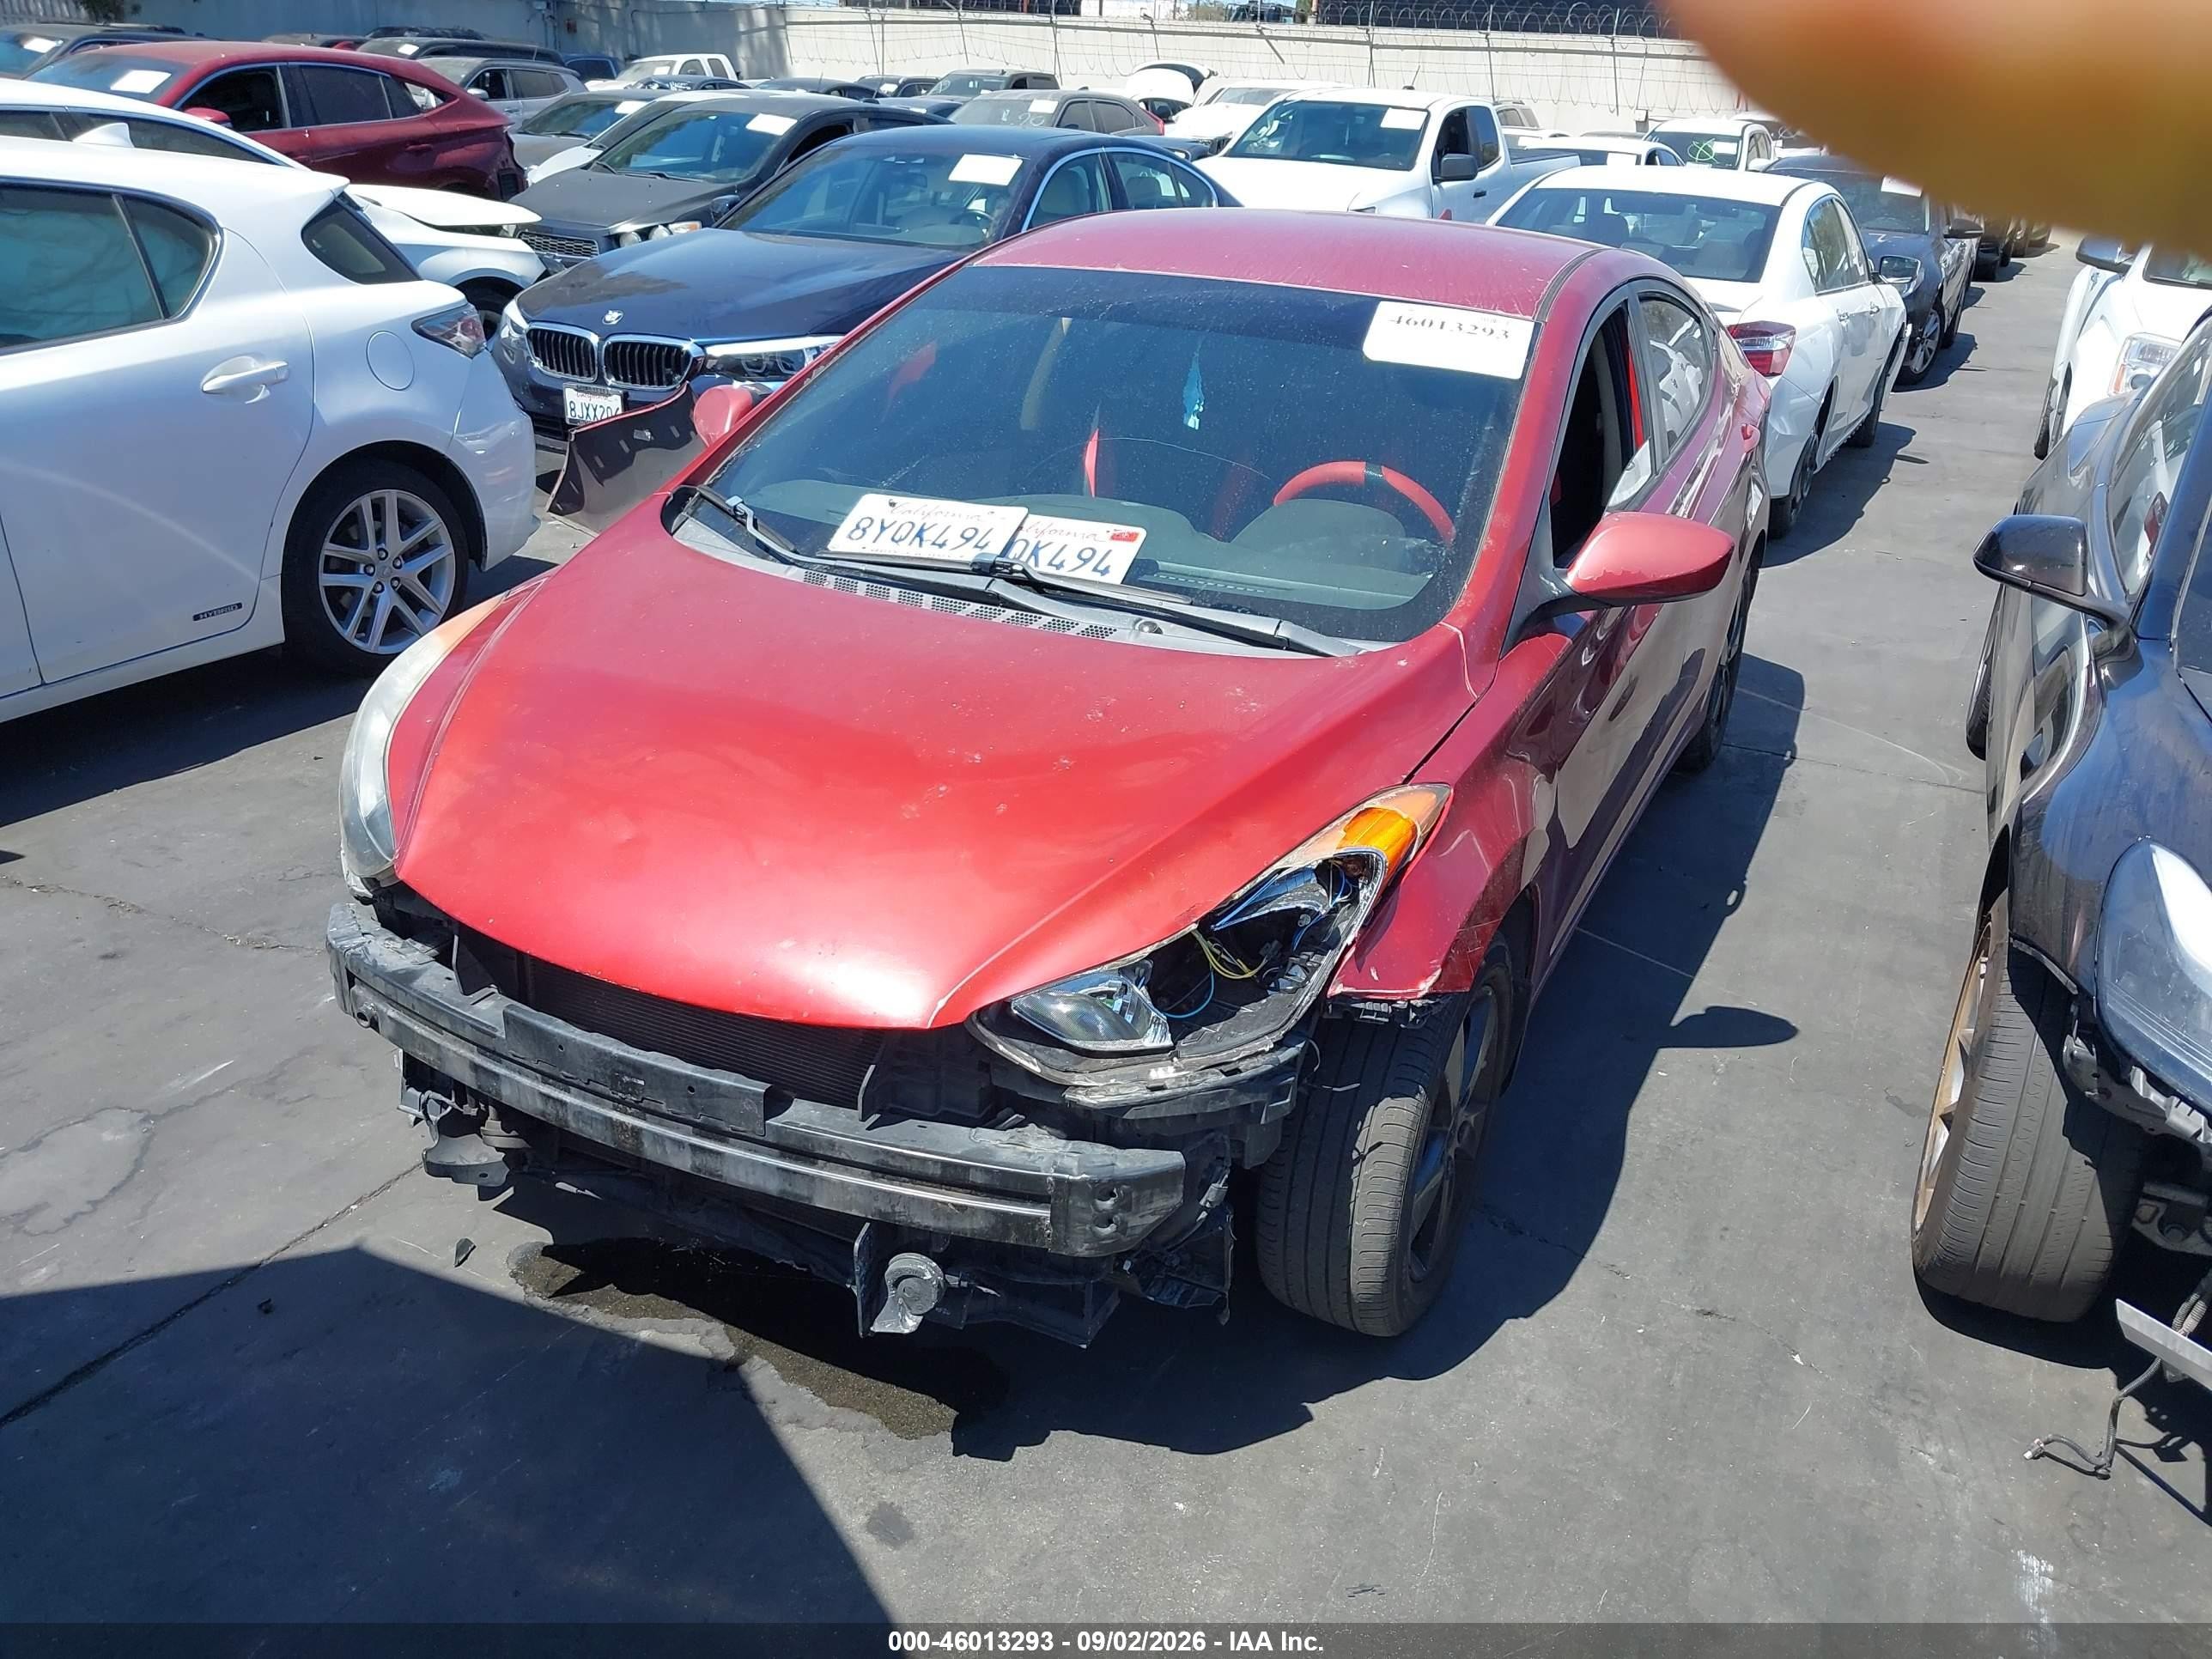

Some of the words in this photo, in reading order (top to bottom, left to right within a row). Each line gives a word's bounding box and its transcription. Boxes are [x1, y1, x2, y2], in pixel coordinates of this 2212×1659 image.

[1388, 315, 1510, 340] 46013293
[847, 516, 994, 551] 8YQK494
[1006, 538, 1113, 577] QK494
[199, 605, 239, 618] HYBRID
